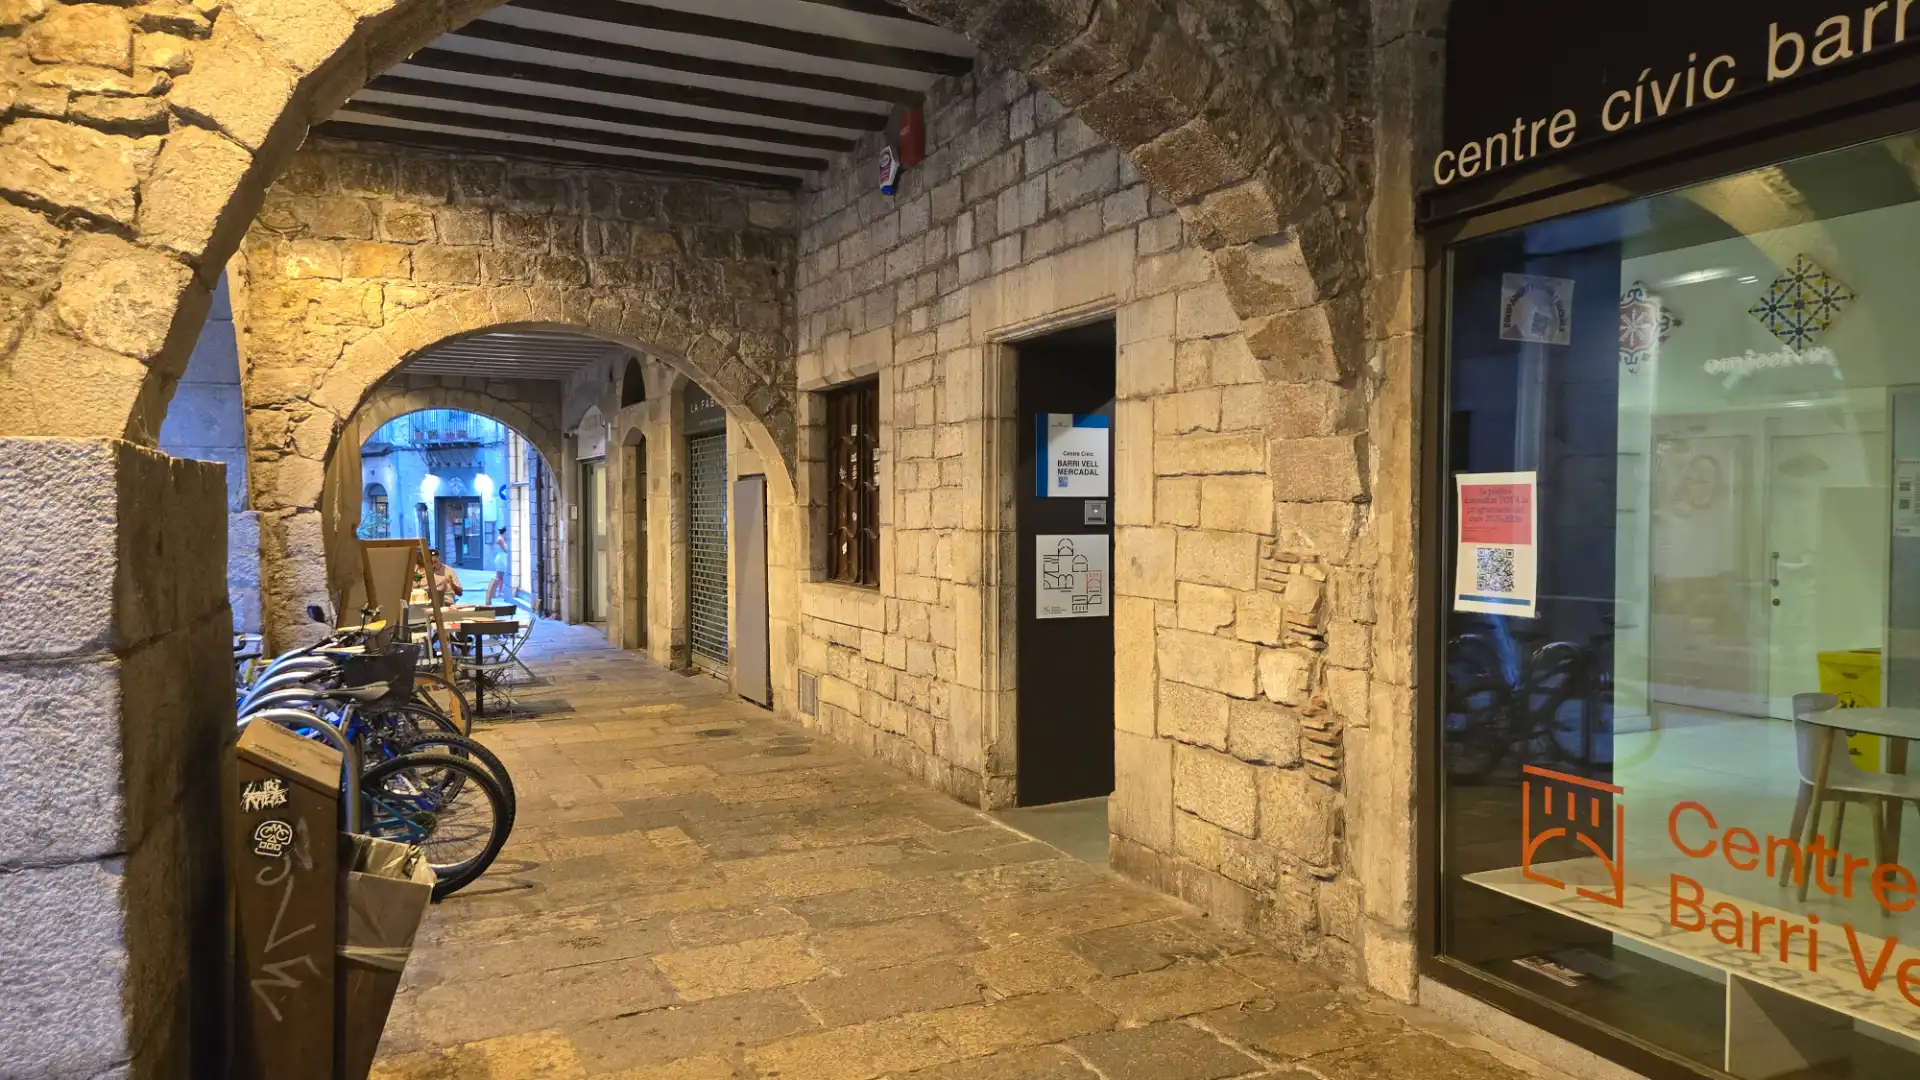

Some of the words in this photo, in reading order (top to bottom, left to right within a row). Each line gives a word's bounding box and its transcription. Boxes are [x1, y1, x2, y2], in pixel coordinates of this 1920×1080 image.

[1433, 107, 1577, 186] centre
[1601, 52, 1736, 132] cívic
[1057, 459, 1080, 468] BARRI
[1081, 460, 1099, 468] VELL
[1057, 468, 1099, 476] MERCADAL
[1667, 800, 1919, 913] Centre
[1670, 872, 1820, 973] Barri
